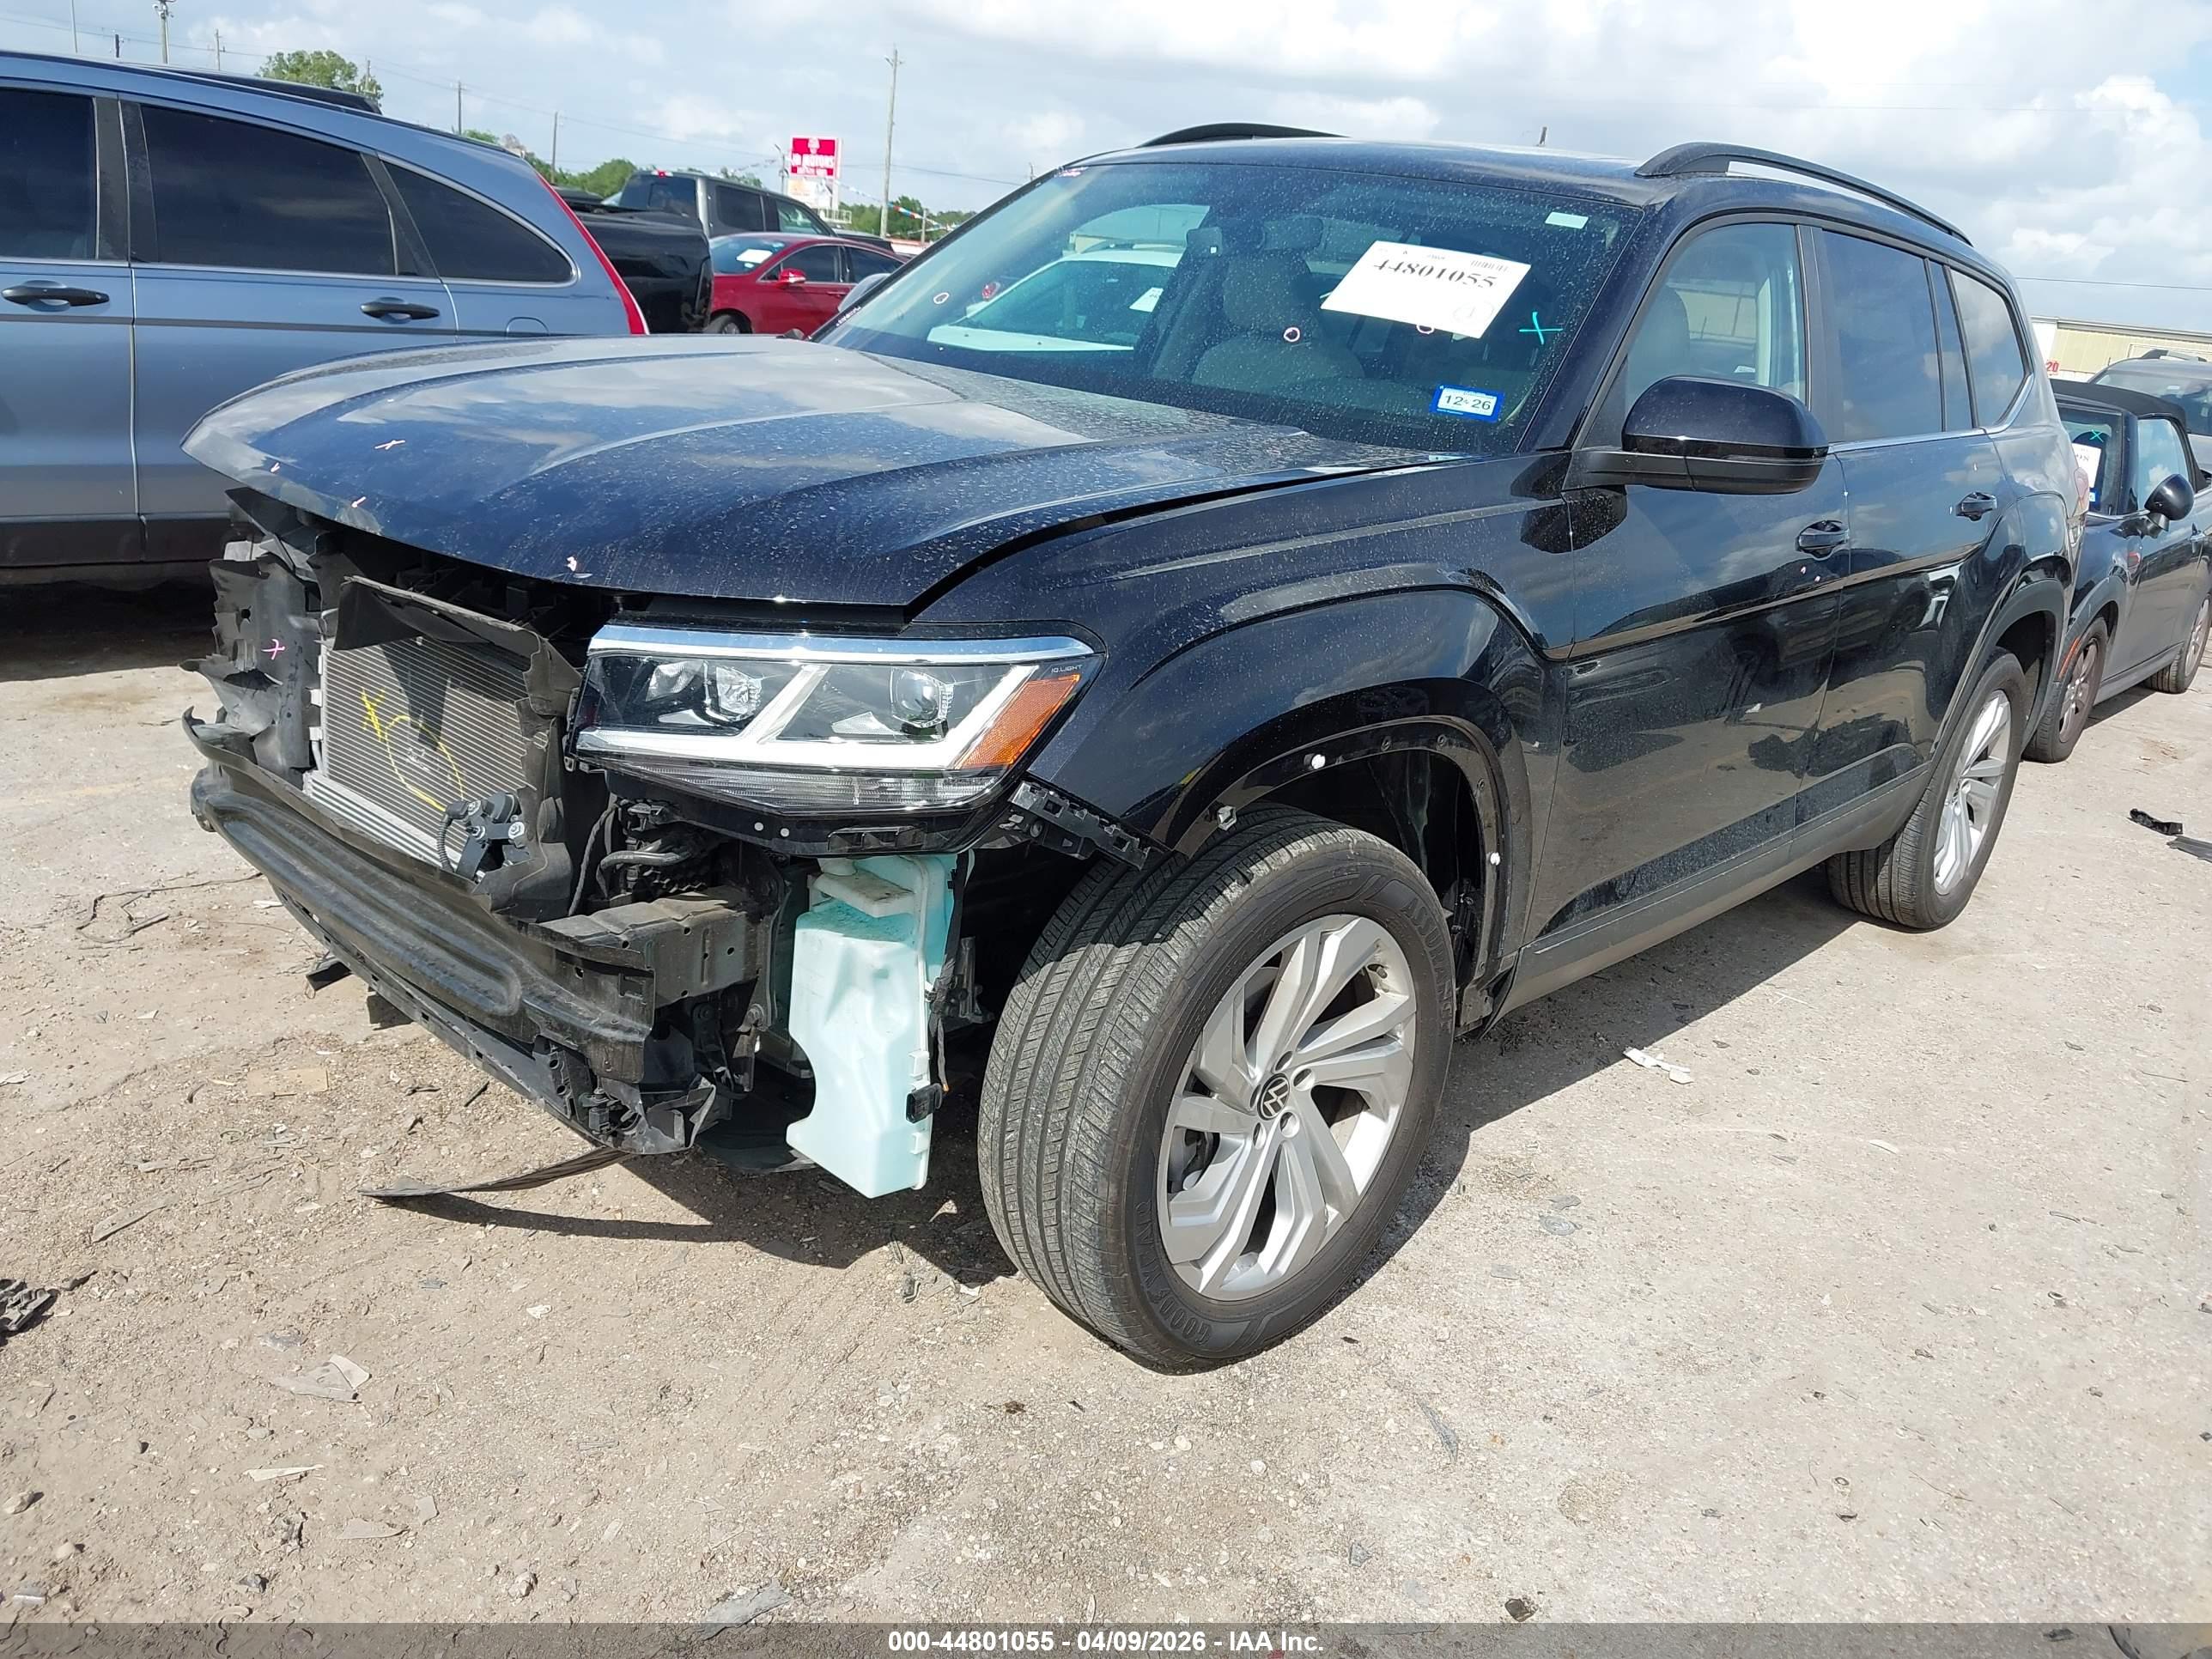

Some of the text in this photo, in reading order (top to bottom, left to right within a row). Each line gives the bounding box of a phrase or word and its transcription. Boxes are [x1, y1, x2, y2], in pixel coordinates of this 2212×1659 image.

[802, 155, 835, 167] MOTORS
[1374, 259, 1498, 289] 44801055
[1445, 394, 1464, 406] 12
[1472, 398, 1492, 410] 26
[1400, 896, 1453, 1035] ASSURANCE
[1134, 1199, 1212, 1346] GOODYEAR
